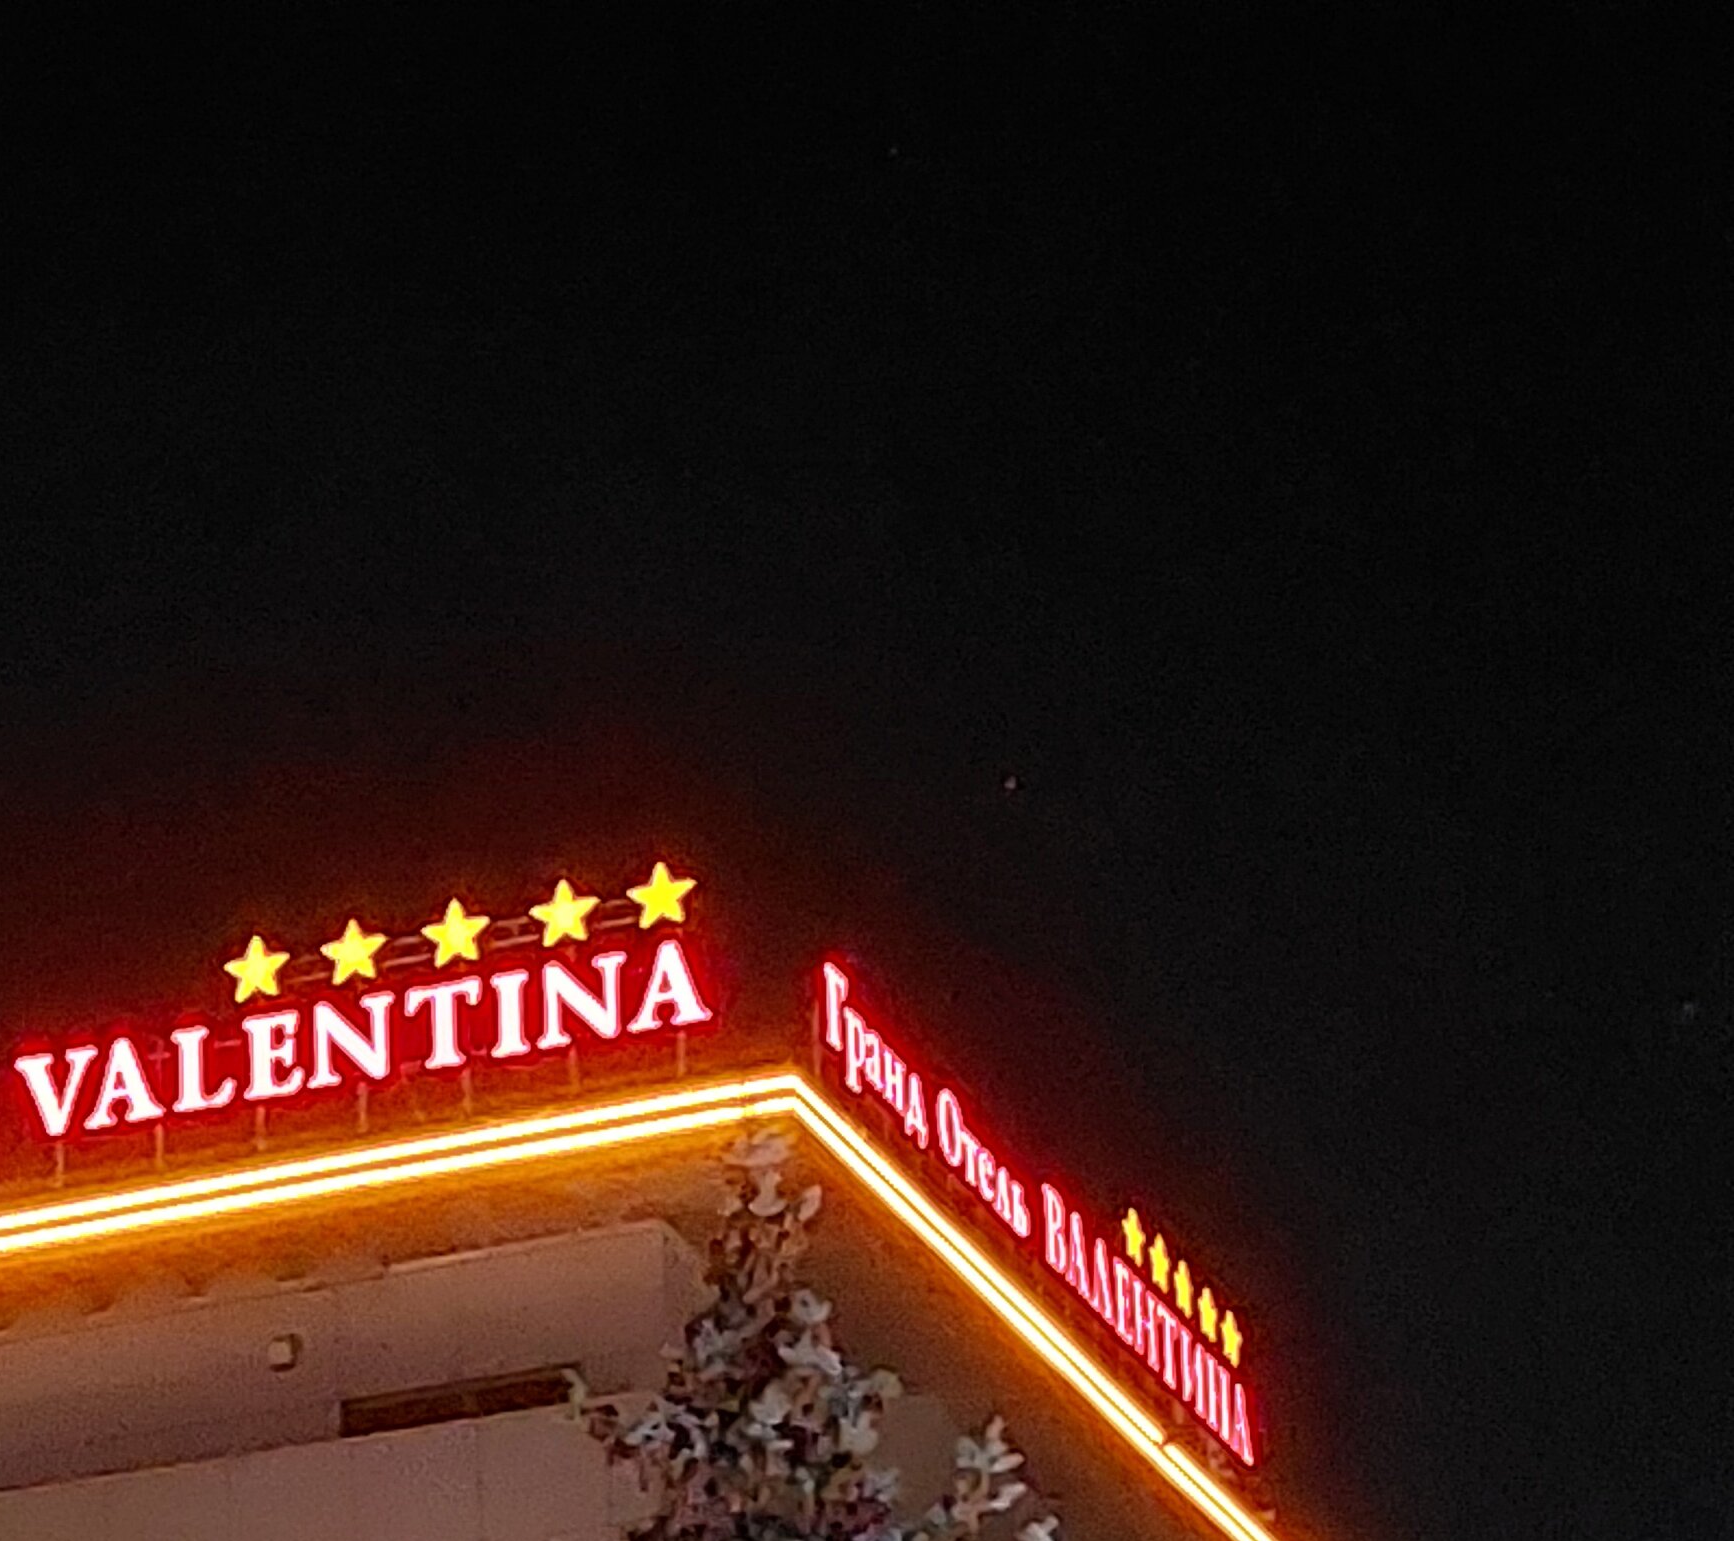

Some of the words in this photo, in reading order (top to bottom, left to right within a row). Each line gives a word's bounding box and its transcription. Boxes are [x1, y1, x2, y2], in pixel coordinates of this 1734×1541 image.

[14, 938, 713, 1138] VALENTINA
[823, 961, 930, 1150] Гранд
[935, 1087, 1032, 1238] Отель
[1040, 1182, 1255, 1467] ВАЛЕНТИНА
